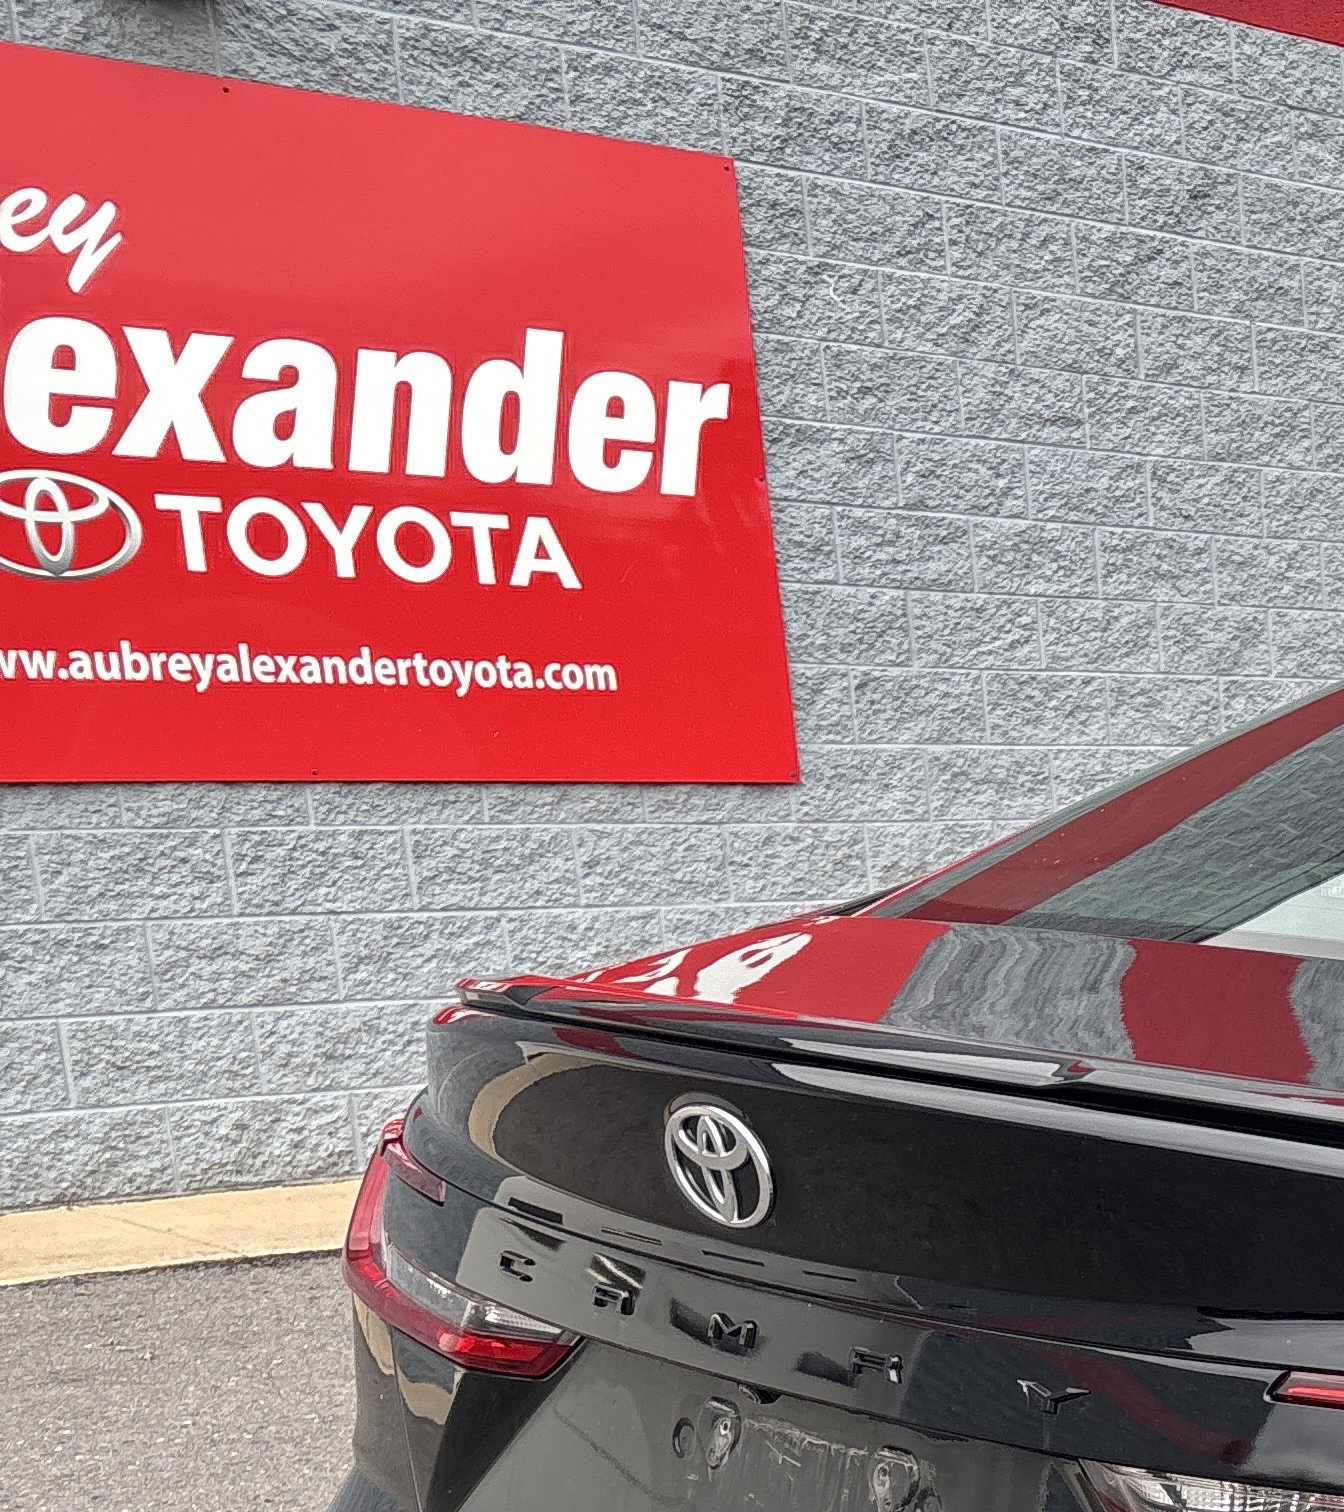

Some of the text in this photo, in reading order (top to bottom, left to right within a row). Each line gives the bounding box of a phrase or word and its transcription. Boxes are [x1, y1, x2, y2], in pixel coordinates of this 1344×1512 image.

[3, 314, 731, 497] exander
[154, 493, 583, 589] TOYOTA
[499, 1249, 1092, 1416] CAMRY
